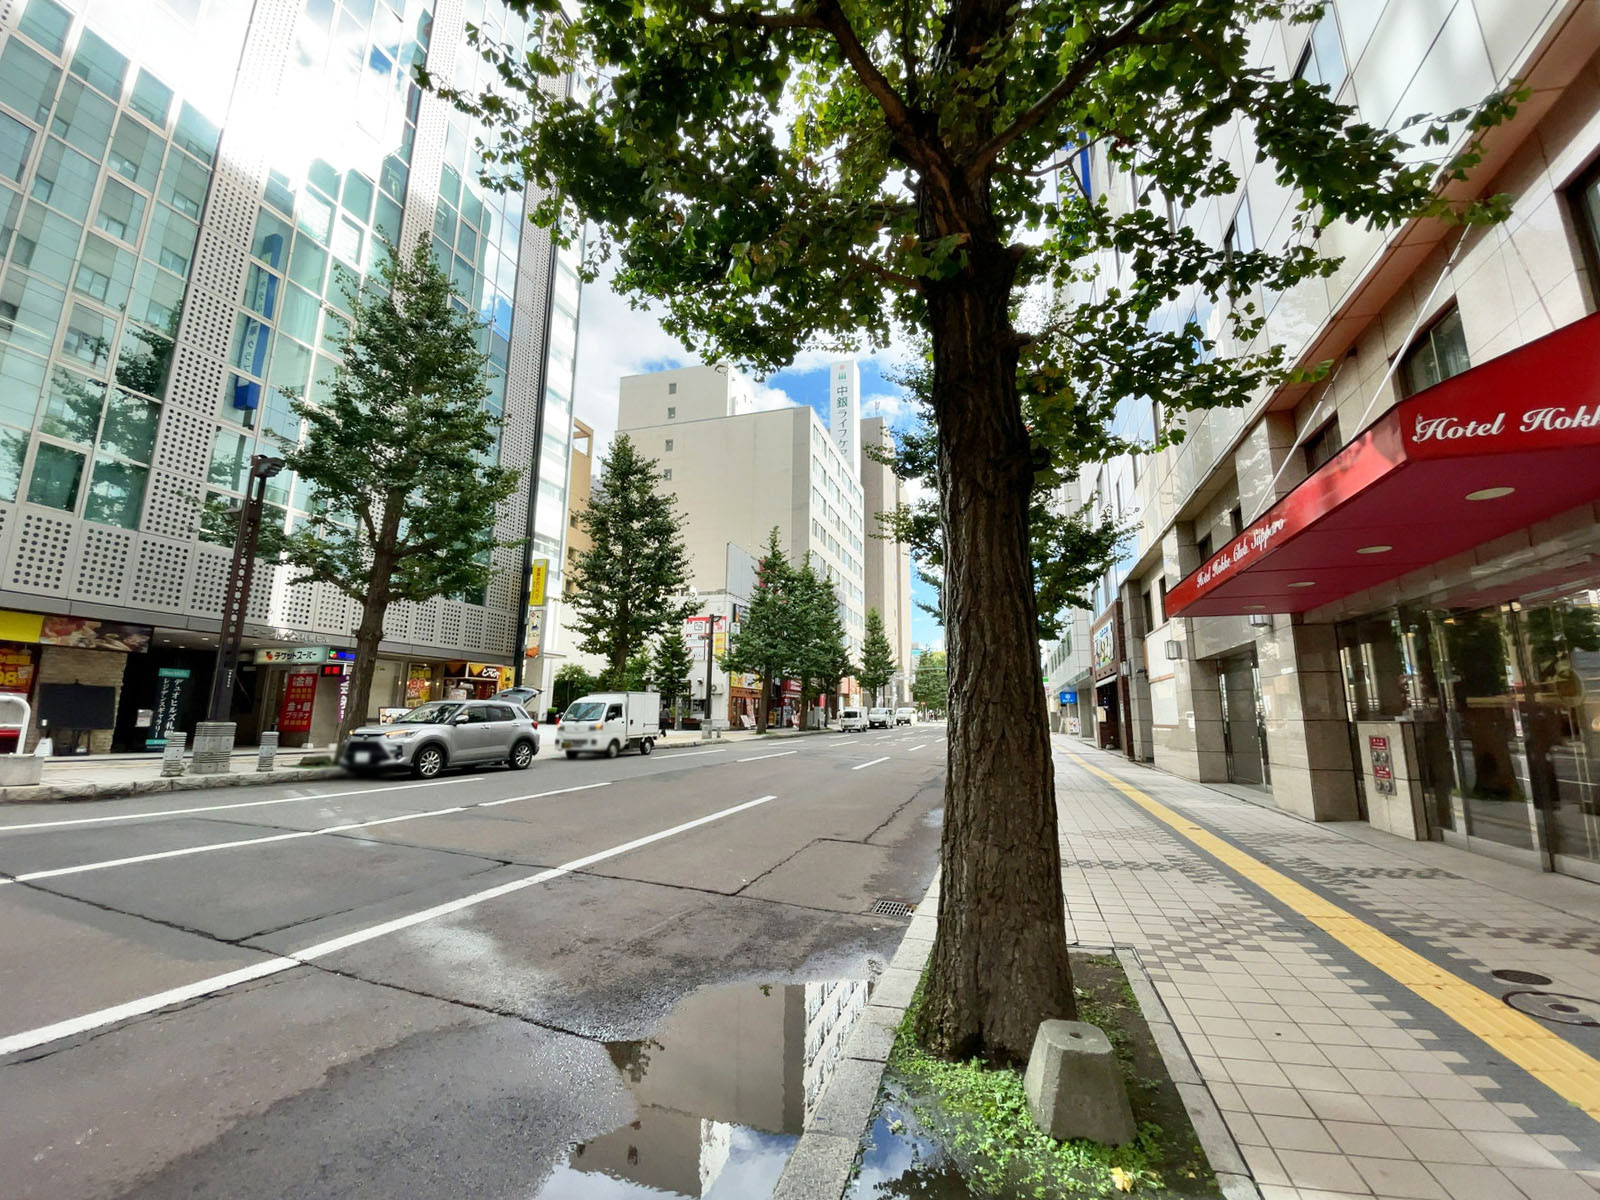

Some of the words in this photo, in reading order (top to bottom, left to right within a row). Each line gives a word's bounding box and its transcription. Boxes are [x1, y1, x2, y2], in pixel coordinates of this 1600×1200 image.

[1412, 412, 1506, 443] Hotel
[1196, 566, 1211, 588] Hotel
[1251, 518, 1288, 551] Sapporo
[274, 651, 317, 660] チケットスーパー
